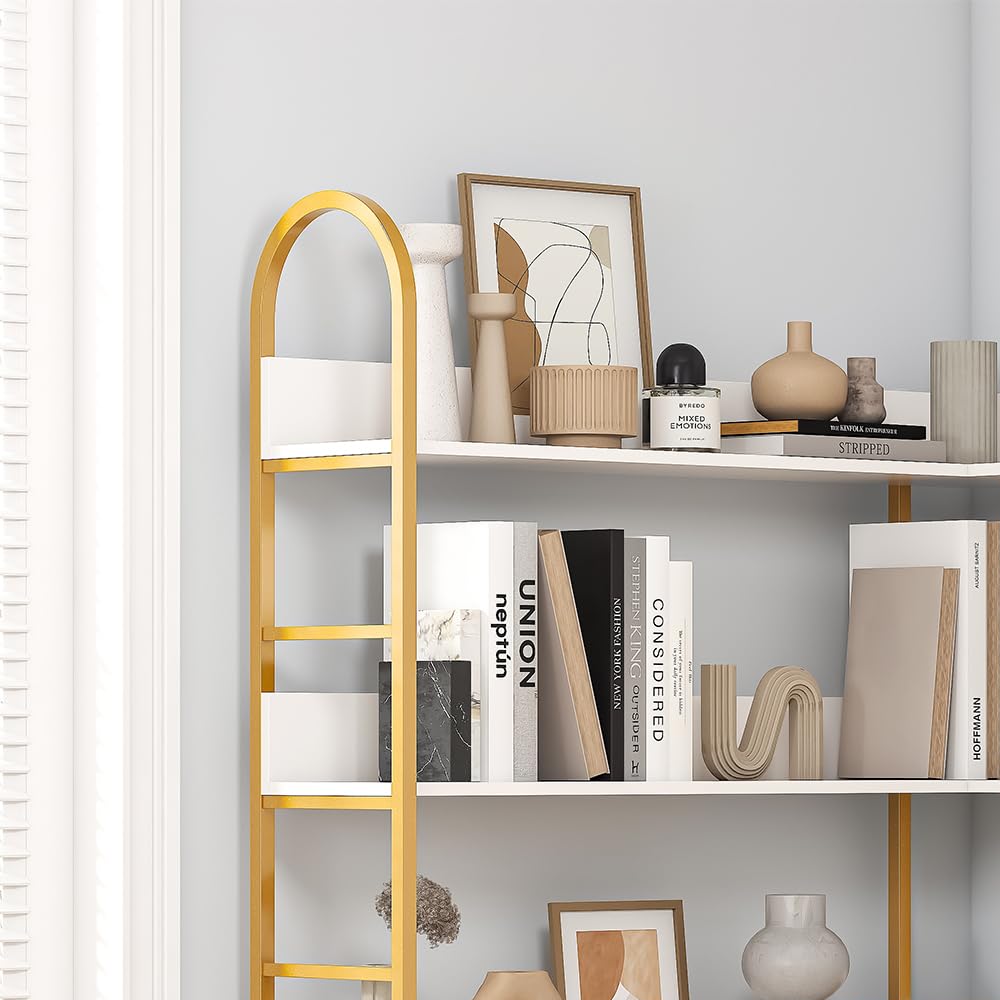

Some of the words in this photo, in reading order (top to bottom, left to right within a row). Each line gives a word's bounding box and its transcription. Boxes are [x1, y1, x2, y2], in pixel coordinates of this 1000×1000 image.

[669, 422, 712, 430] EMOTIONS
[678, 415, 706, 423] MIXED
[839, 442, 890, 456] STRIPPED
[630, 555, 641, 622] STEPHEN
[491, 593, 511, 679] neptún
[519, 579, 536, 688] UNION
[613, 597, 622, 647] FASHION
[613, 649, 622, 681] YORK
[630, 624, 642, 679] KING
[652, 598, 665, 742] CONSIDERED
[613, 683, 622, 710] NEW
[631, 684, 640, 753] OUTSIDER
[972, 697, 982, 761] HOFFMANN
